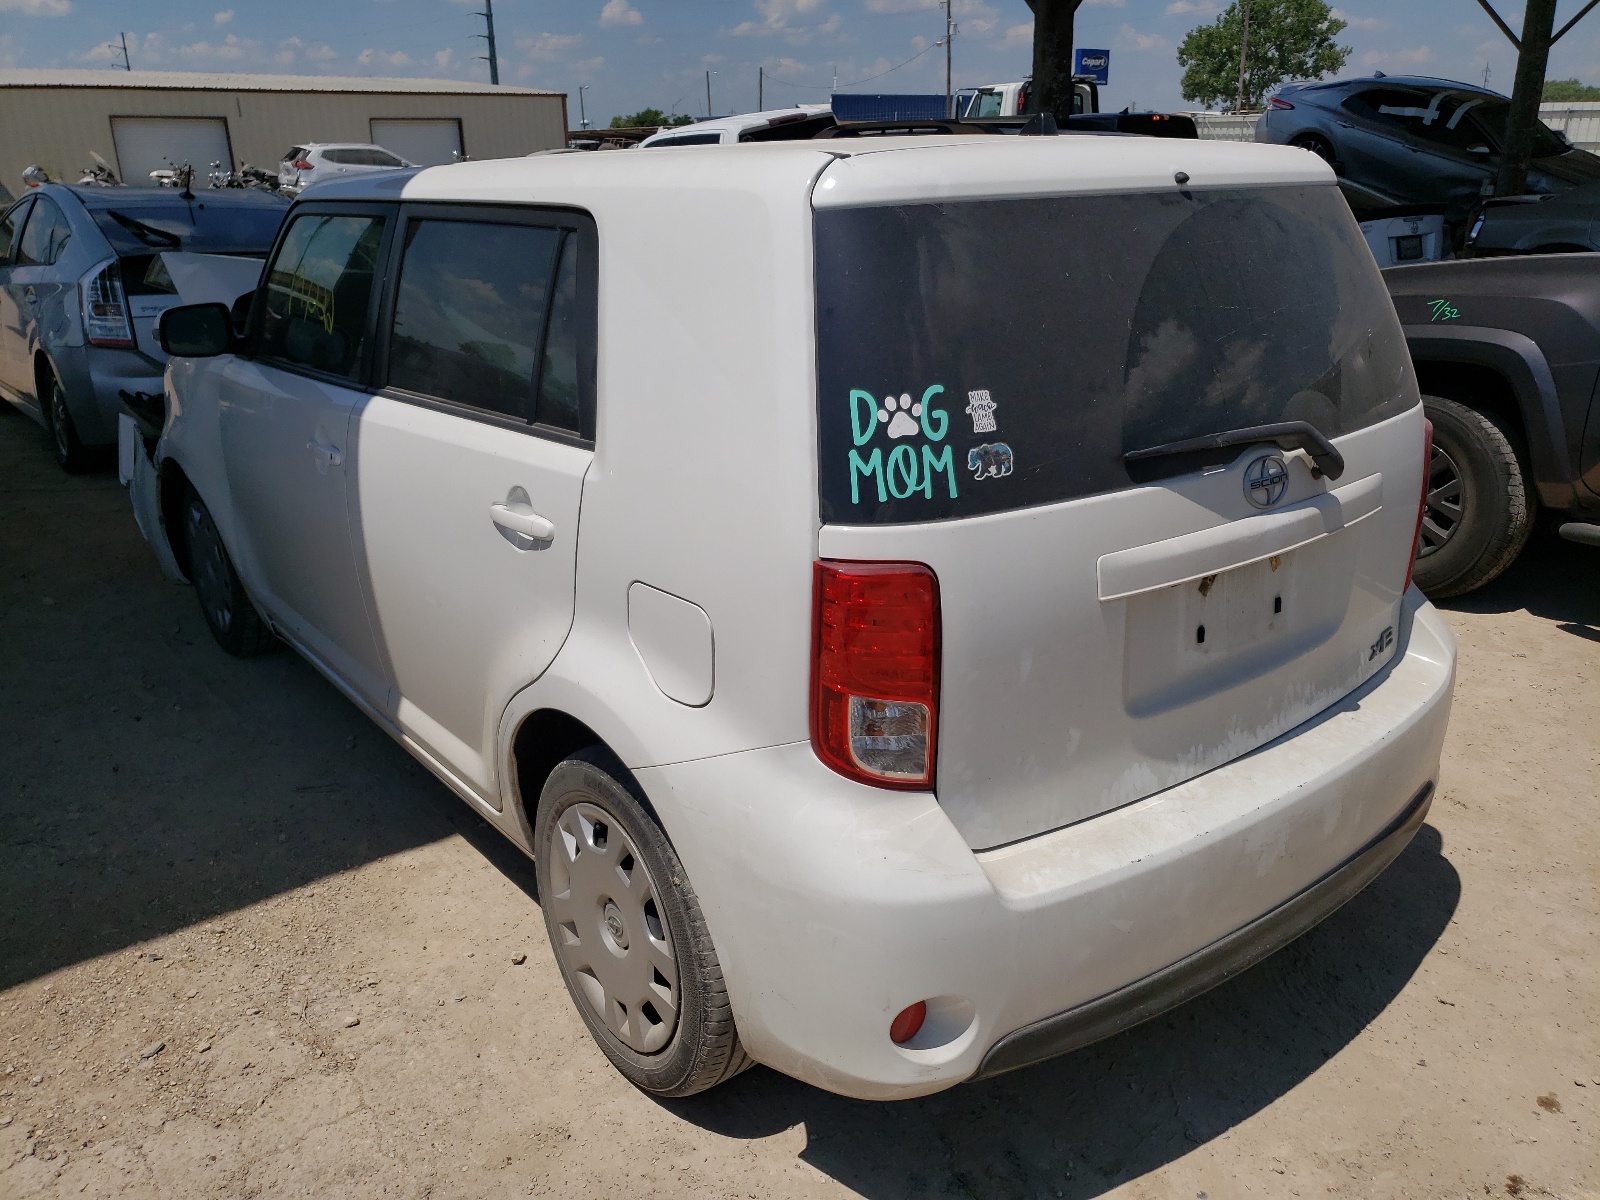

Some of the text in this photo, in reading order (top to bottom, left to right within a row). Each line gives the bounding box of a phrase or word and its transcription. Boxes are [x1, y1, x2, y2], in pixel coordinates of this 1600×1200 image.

[1082, 57, 1105, 67] Copart
[1426, 299, 1461, 321] 7/32
[969, 391, 989, 401] MAKE
[973, 411, 993, 422] LAME
[975, 421, 995, 431] AGAIN
[849, 444, 957, 504] MOM
